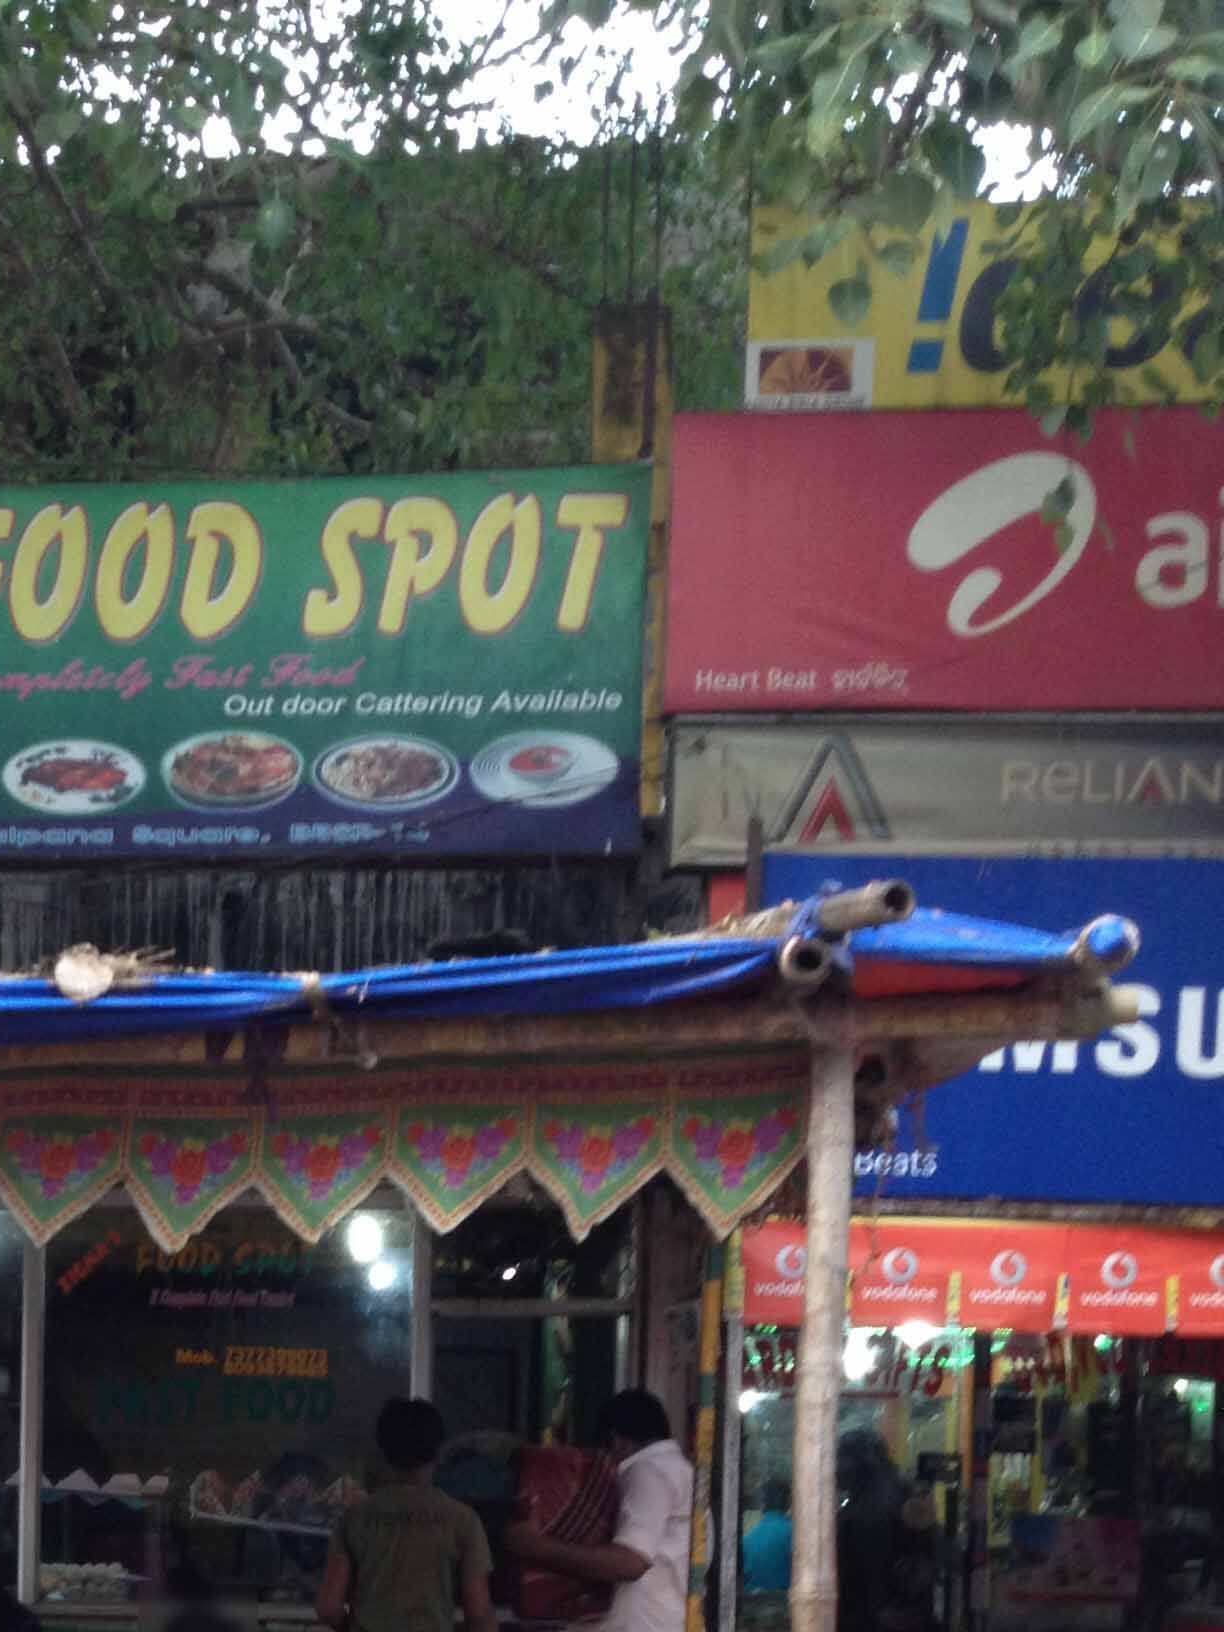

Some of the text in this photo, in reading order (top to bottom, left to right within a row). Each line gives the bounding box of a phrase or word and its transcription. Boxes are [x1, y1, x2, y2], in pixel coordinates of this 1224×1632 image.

[302, 493, 629, 639] SPOT
[260, 654, 367, 690] Food
[695, 668, 761, 691] Heart
[767, 667, 817, 690] Beat
[223, 689, 624, 720] Out door Cattering Available
[861, 1283, 938, 1303] vodafone
[970, 1285, 1047, 1305] vodafone
[1081, 1287, 1159, 1308] vodafone
